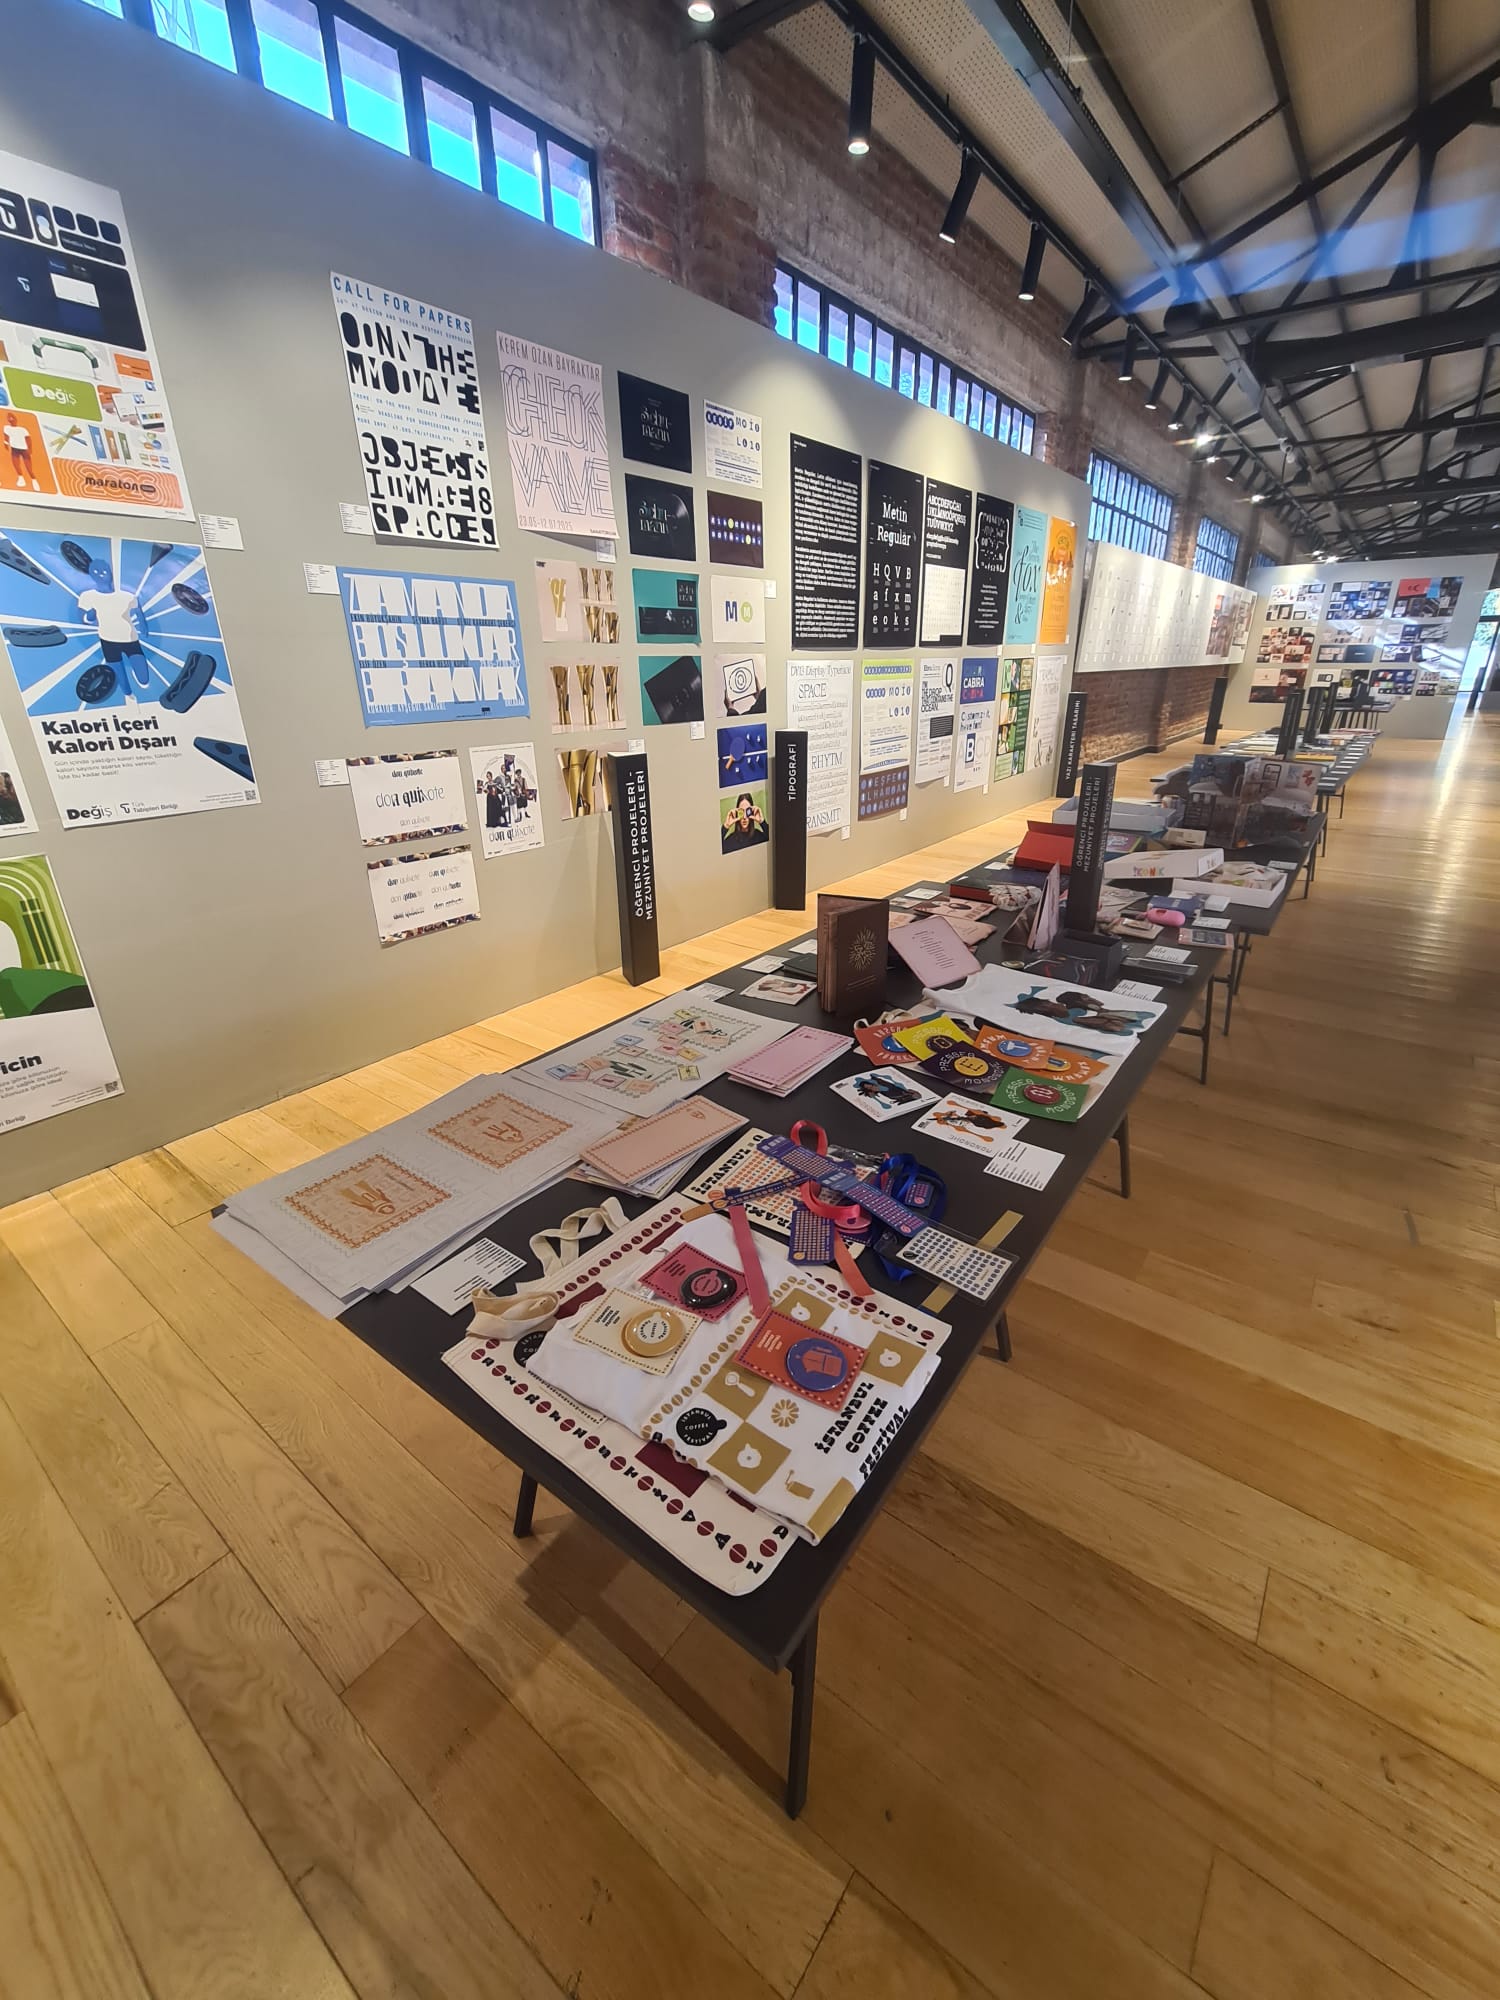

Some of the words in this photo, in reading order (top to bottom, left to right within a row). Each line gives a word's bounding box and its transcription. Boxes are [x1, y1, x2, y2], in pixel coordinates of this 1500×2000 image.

[333, 276, 373, 301] CALL
[384, 293, 411, 314] FOR
[419, 305, 471, 334] PAPERS
[499, 335, 529, 360] KEREM
[532, 346, 553, 368] OZAN
[556, 354, 601, 382] BAYRAKTAR
[30, 383, 77, 405] Değiş
[501, 365, 608, 454] CHECK
[85, 475, 139, 492] maraton
[881, 502, 908, 523] Metin
[877, 525, 912, 548] Regular
[873, 563, 880, 577] H
[884, 564, 892, 582] Q
[895, 565, 902, 579] V
[906, 567, 911, 580] B
[873, 590, 879, 601] a
[884, 588, 889, 602] f
[894, 592, 900, 603] x
[904, 593, 912, 604] m
[725, 600, 738, 622] M
[873, 615, 878, 625] e
[883, 615, 888, 625] o
[893, 612, 899, 626] k
[904, 616, 910, 626] s
[798, 683, 827, 699] SPACE
[963, 677, 985, 689] CABIRA
[42, 718, 110, 735] Kalori
[112, 715, 159, 734] İçeri
[48, 737, 115, 755] Kalori
[118, 735, 177, 751] Dışarı
[811, 752, 842, 770] RHYTM
[787, 743, 797, 802] TİPOGRAFİ
[375, 793, 400, 808] don
[402, 786, 445, 808] quixote
[635, 770, 648, 844] PROJELERİ
[66, 805, 113, 820] Değiş
[625, 782, 640, 855] PROJELERİ
[806, 807, 841, 829] RANSMIT
[489, 828, 505, 843] don
[632, 859, 644, 917] ÖĞRENCİ
[642, 848, 653, 920] MEZUNİYET
[690, 1147, 751, 1195] İSTANBUL
[814, 1382, 874, 1454] İSTANBUL
[845, 1397, 888, 1453] COFFEE
[859, 1405, 909, 1480] FESTİVAL
